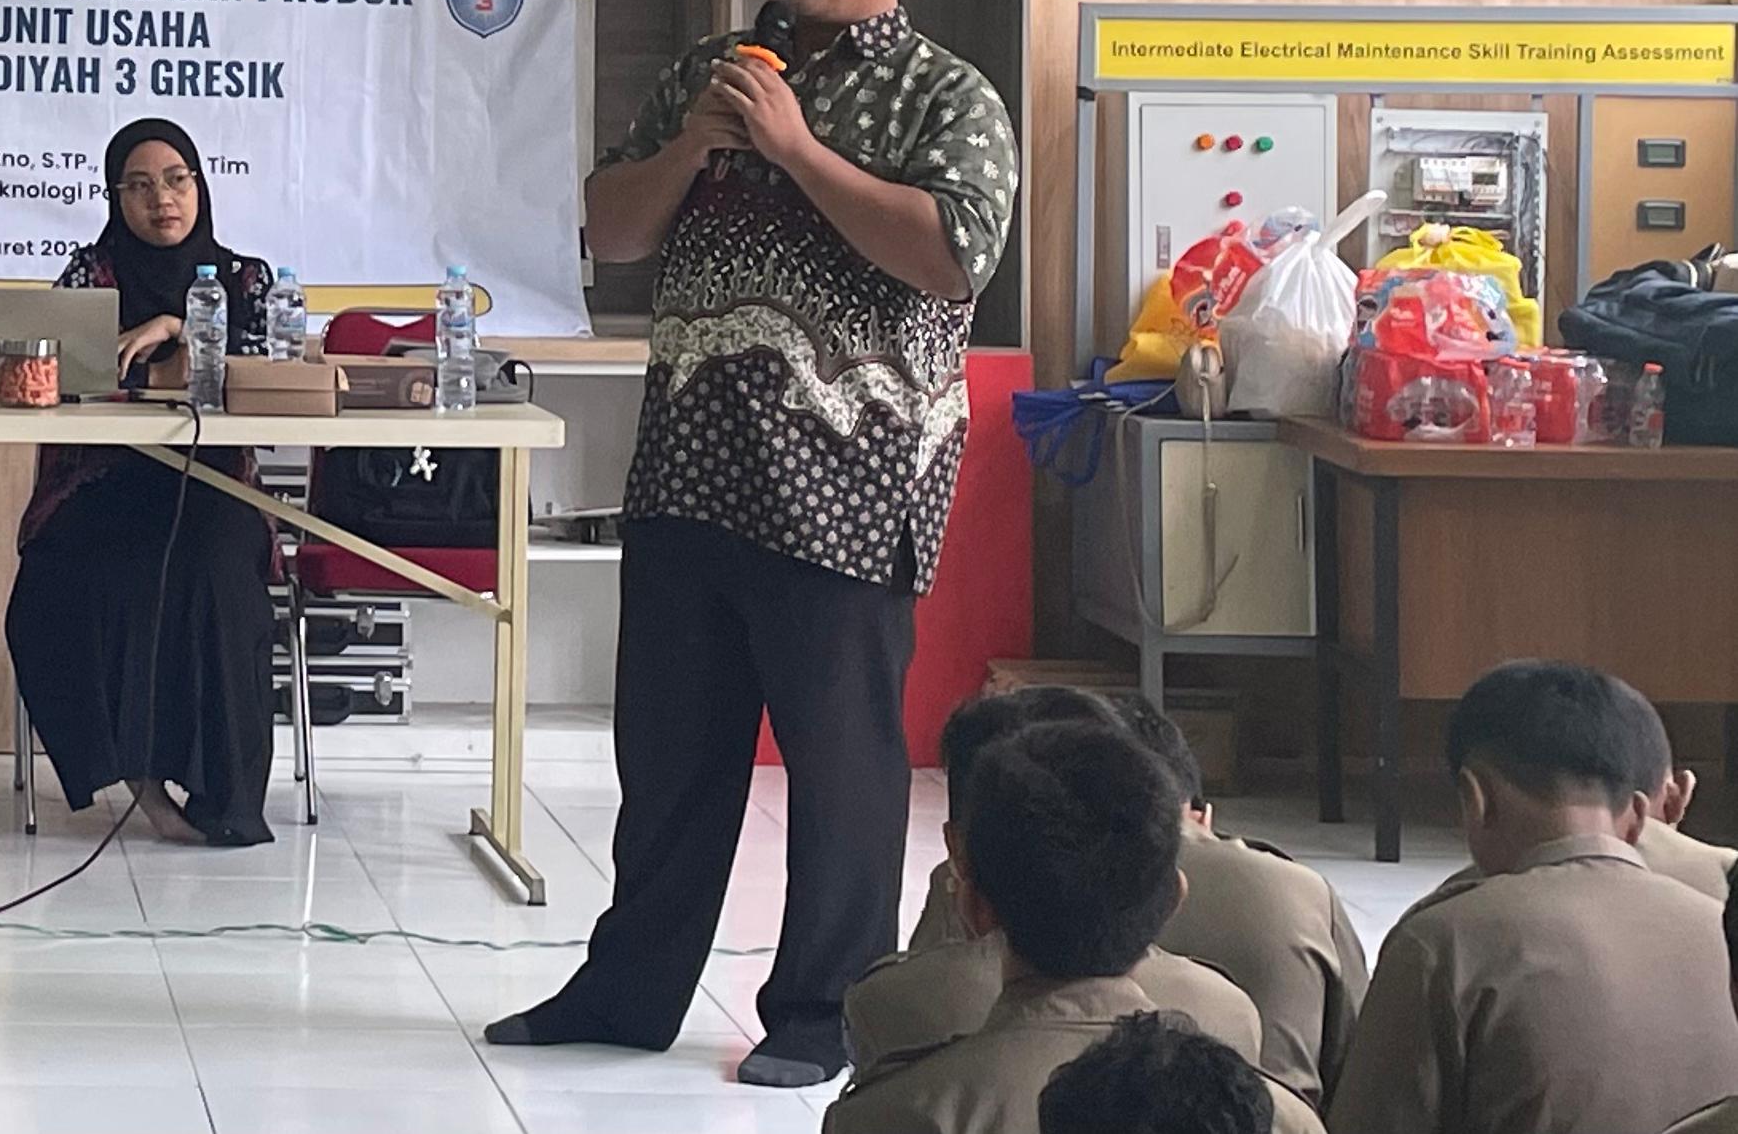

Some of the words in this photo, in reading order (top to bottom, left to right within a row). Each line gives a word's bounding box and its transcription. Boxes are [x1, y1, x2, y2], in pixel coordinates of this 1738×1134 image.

[86, 8, 211, 49] USAHA
[1112, 40, 1234, 58] Intermediate
[1240, 41, 1331, 59] Electrical
[1337, 42, 1462, 60] Maintenance
[1468, 42, 1510, 60] Skill
[1515, 43, 1597, 64] Training
[1601, 43, 1725, 61] Assessment
[115, 57, 137, 96] 3
[150, 58, 285, 99] GRESIK
[206, 155, 250, 175] Tim
[40, 239, 82, 257] 202
